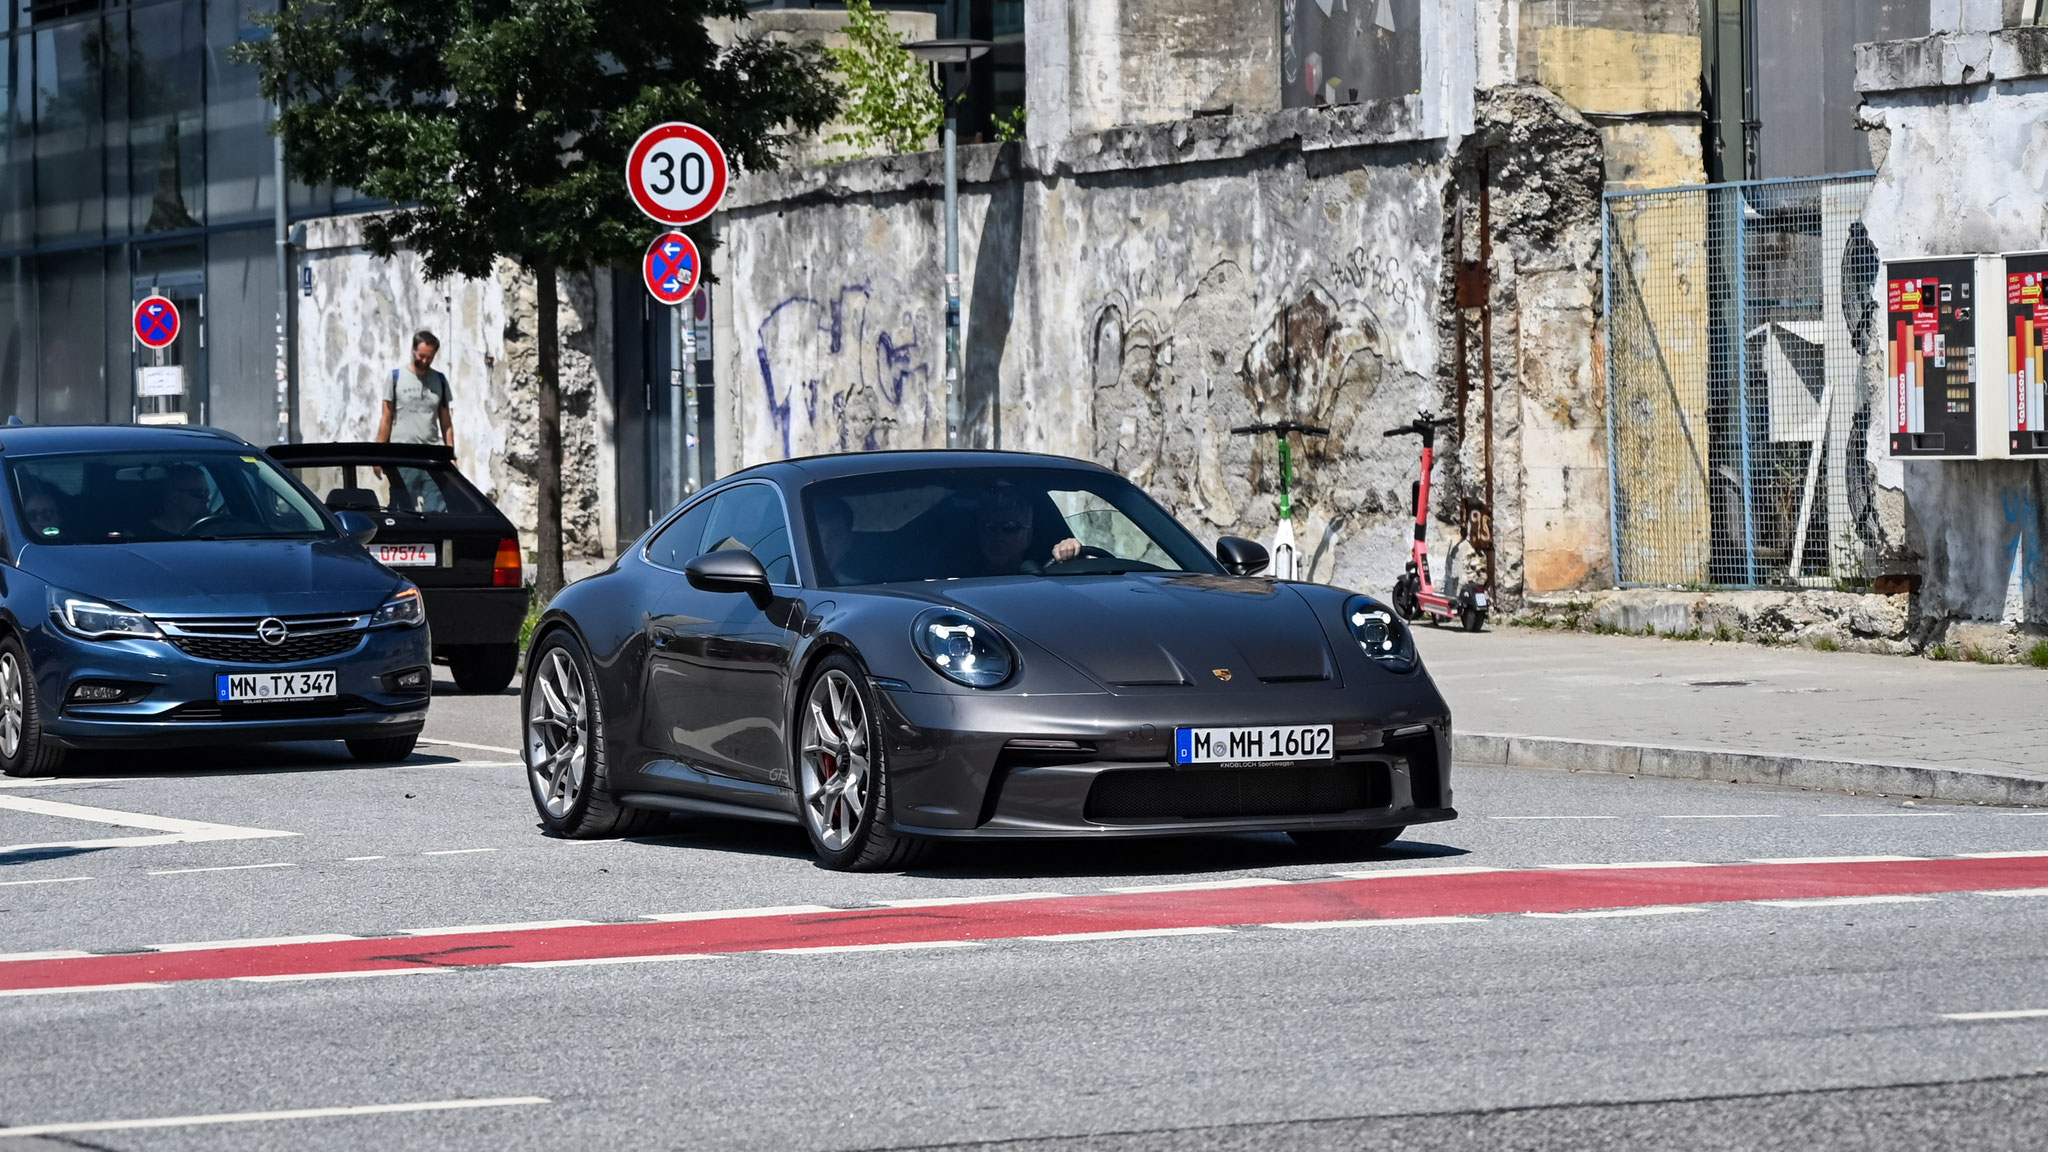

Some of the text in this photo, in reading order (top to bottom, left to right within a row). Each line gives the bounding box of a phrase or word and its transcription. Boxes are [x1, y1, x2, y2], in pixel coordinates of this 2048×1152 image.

[650, 152, 704, 195] 30
[381, 545, 427, 561] 07574
[230, 677, 256, 697] MN
[270, 675, 295, 695] TX
[300, 673, 335, 694] 347
[1181, 728, 1330, 758] D M MH 1602
[1258, 760, 1294, 768] Sportwagen
